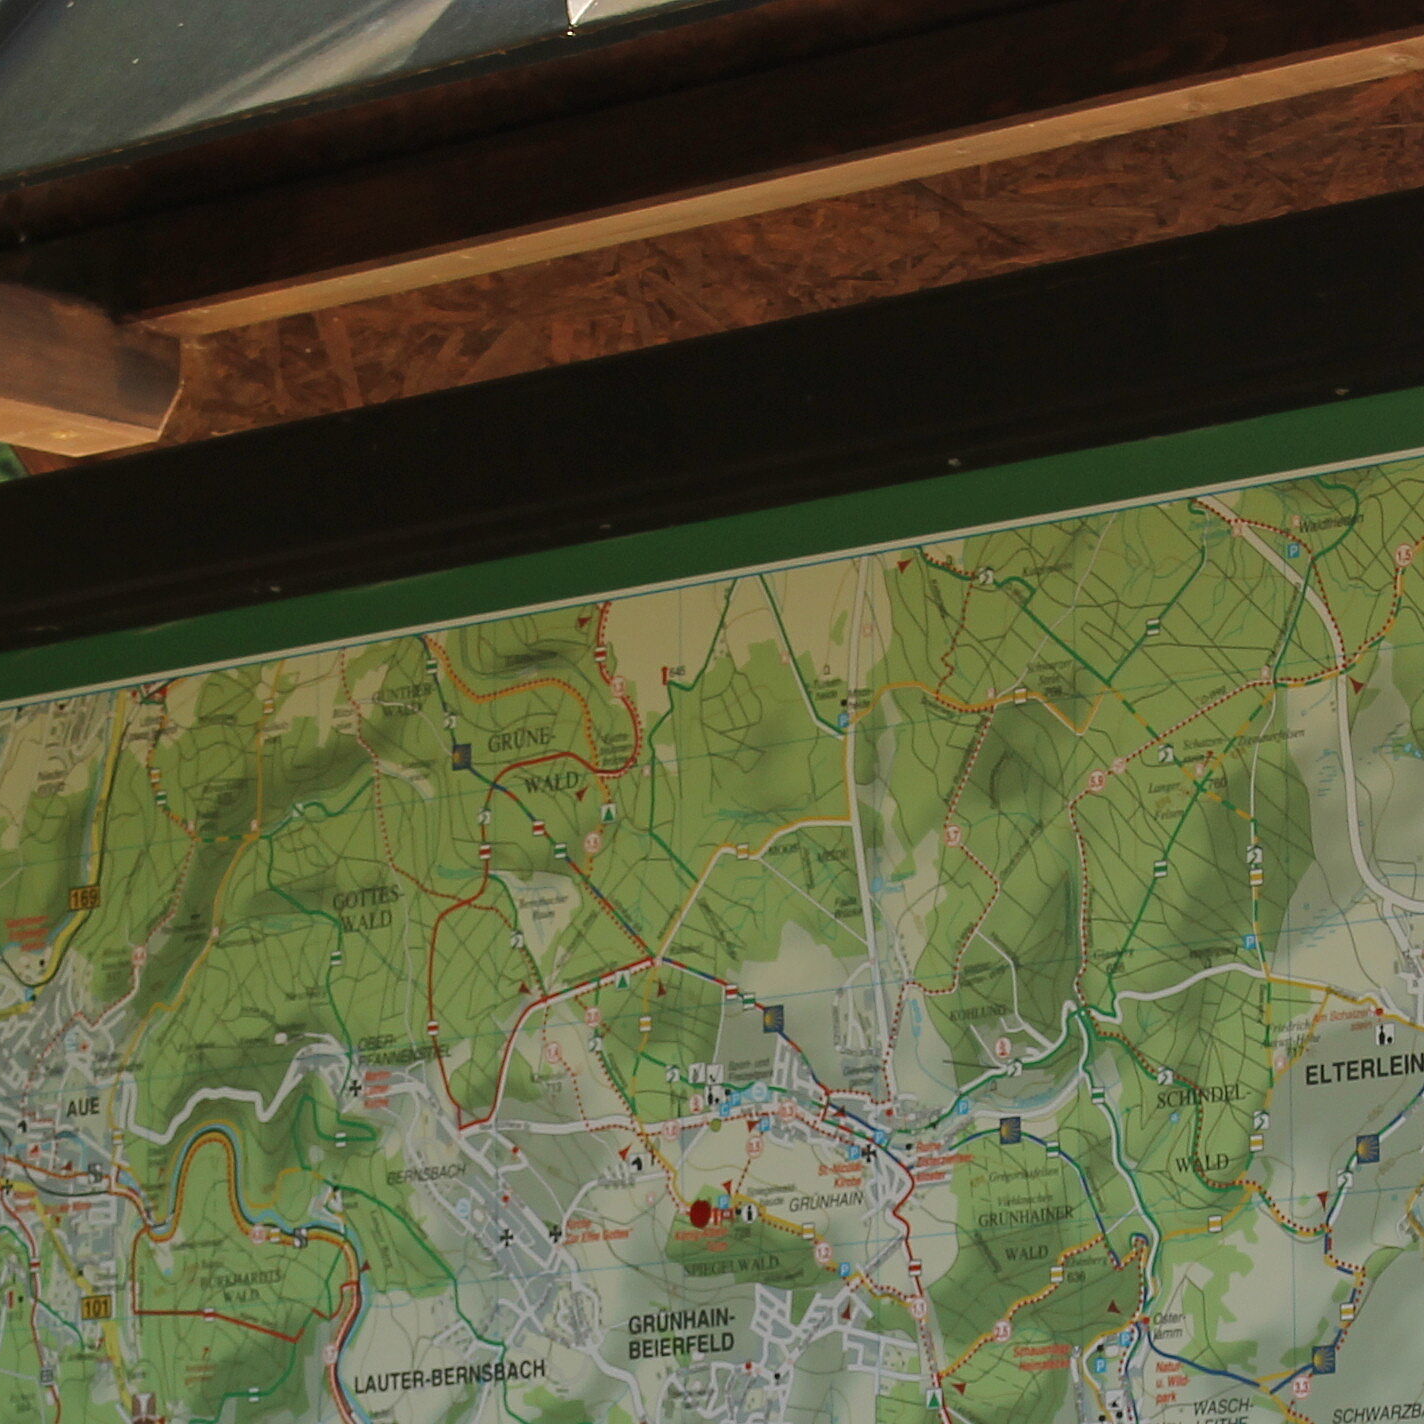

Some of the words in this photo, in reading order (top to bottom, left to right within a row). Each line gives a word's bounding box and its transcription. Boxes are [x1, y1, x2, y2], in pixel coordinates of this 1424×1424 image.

[524, 771, 579, 795] WALD
[342, 910, 392, 932] WALD
[1156, 1083, 1252, 1110] SCHINDEL-
[67, 1098, 100, 1118] AUE
[1176, 1153, 1229, 1173] WALD
[387, 1164, 467, 1186] BERNSBACH
[788, 1190, 864, 1212] GRÜNHAIN
[977, 1202, 1075, 1229] GRÜNHAINER
[1005, 1243, 1050, 1263] WALD
[84, 1297, 110, 1319] 101
[628, 1309, 736, 1336] GRÜNHAIN-
[628, 1332, 735, 1360] BEIERFELD
[354, 1358, 546, 1395] LAUTER-BERNSBACH
[1193, 1398, 1254, 1416] WASCH-
